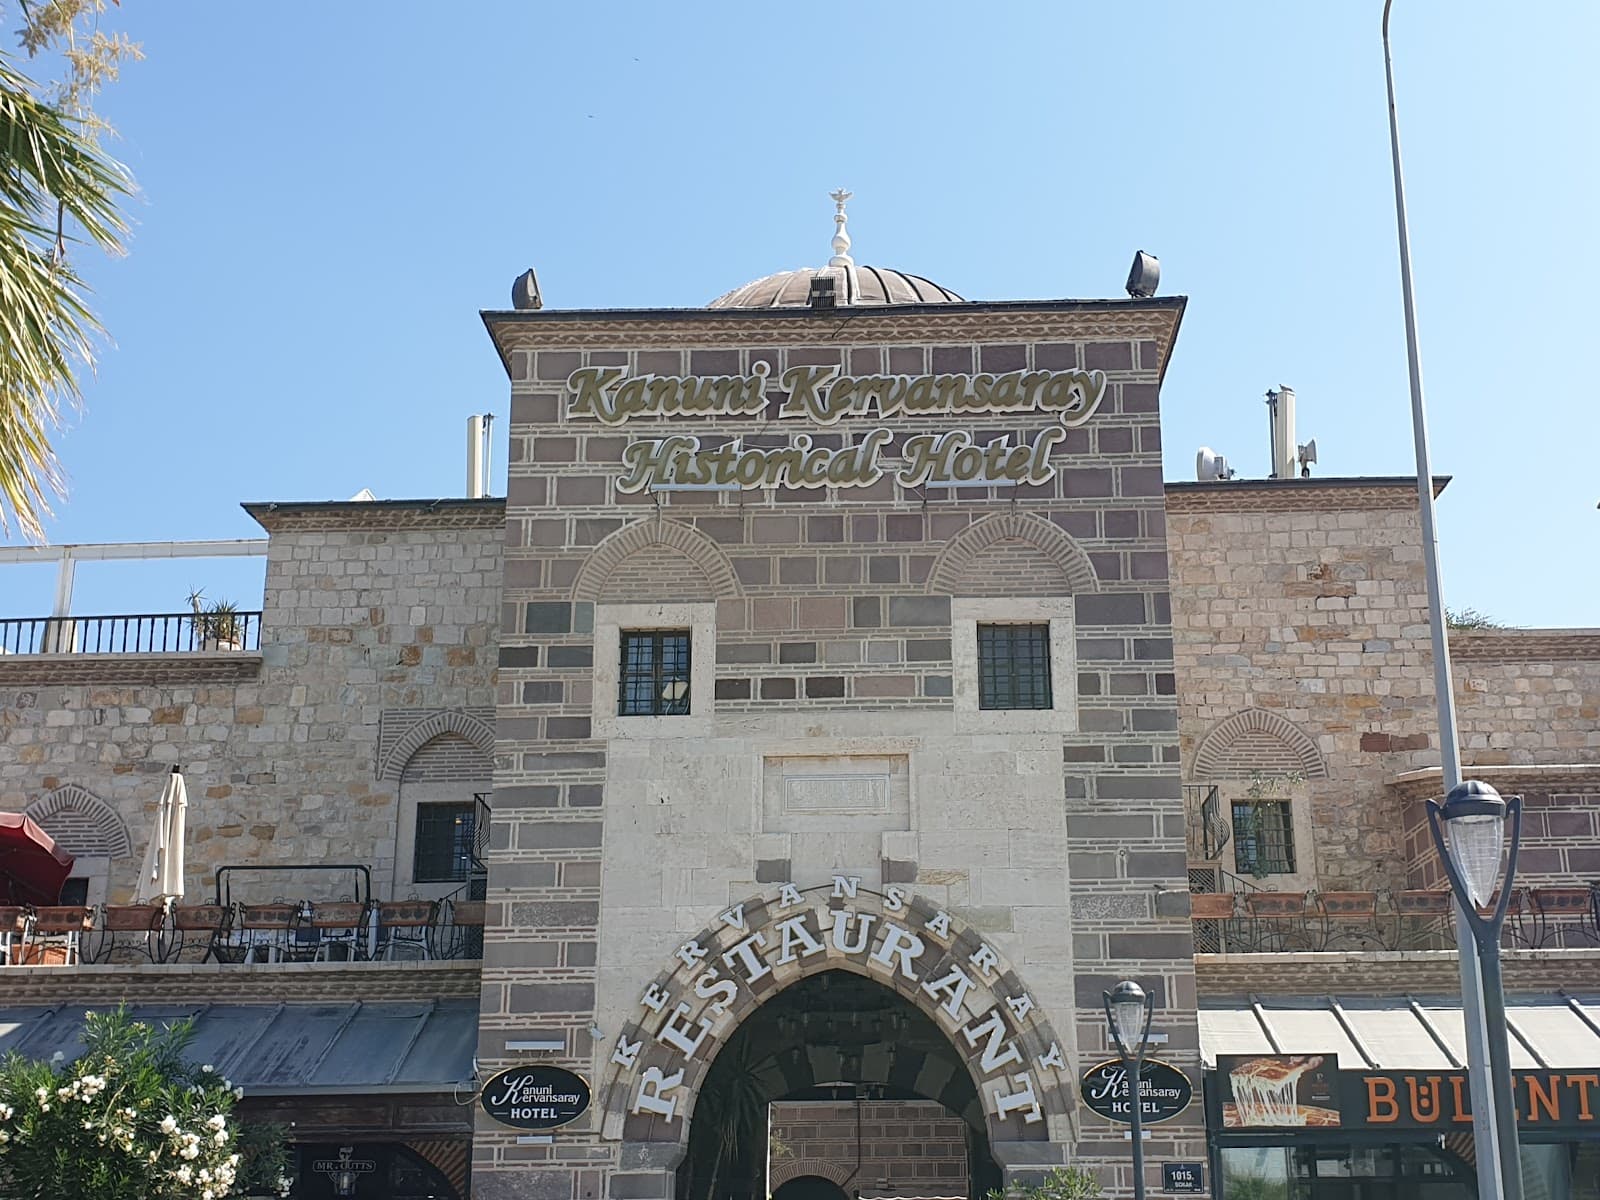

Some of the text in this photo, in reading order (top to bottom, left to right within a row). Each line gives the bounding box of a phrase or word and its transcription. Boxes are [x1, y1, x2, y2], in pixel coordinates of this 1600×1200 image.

[566, 360, 1108, 428] Kanuni Kervansaray
[616, 426, 1067, 494] Historical Hotel
[610, 875, 1066, 1072] KERVANSARAY
[633, 909, 1044, 1124] RESTAURANT
[491, 1075, 553, 1106] Kanuni
[511, 1108, 557, 1119] HOTEL
[1363, 1074, 1600, 1123] BÜLNT
[1171, 1170, 1195, 1180] 1015.
